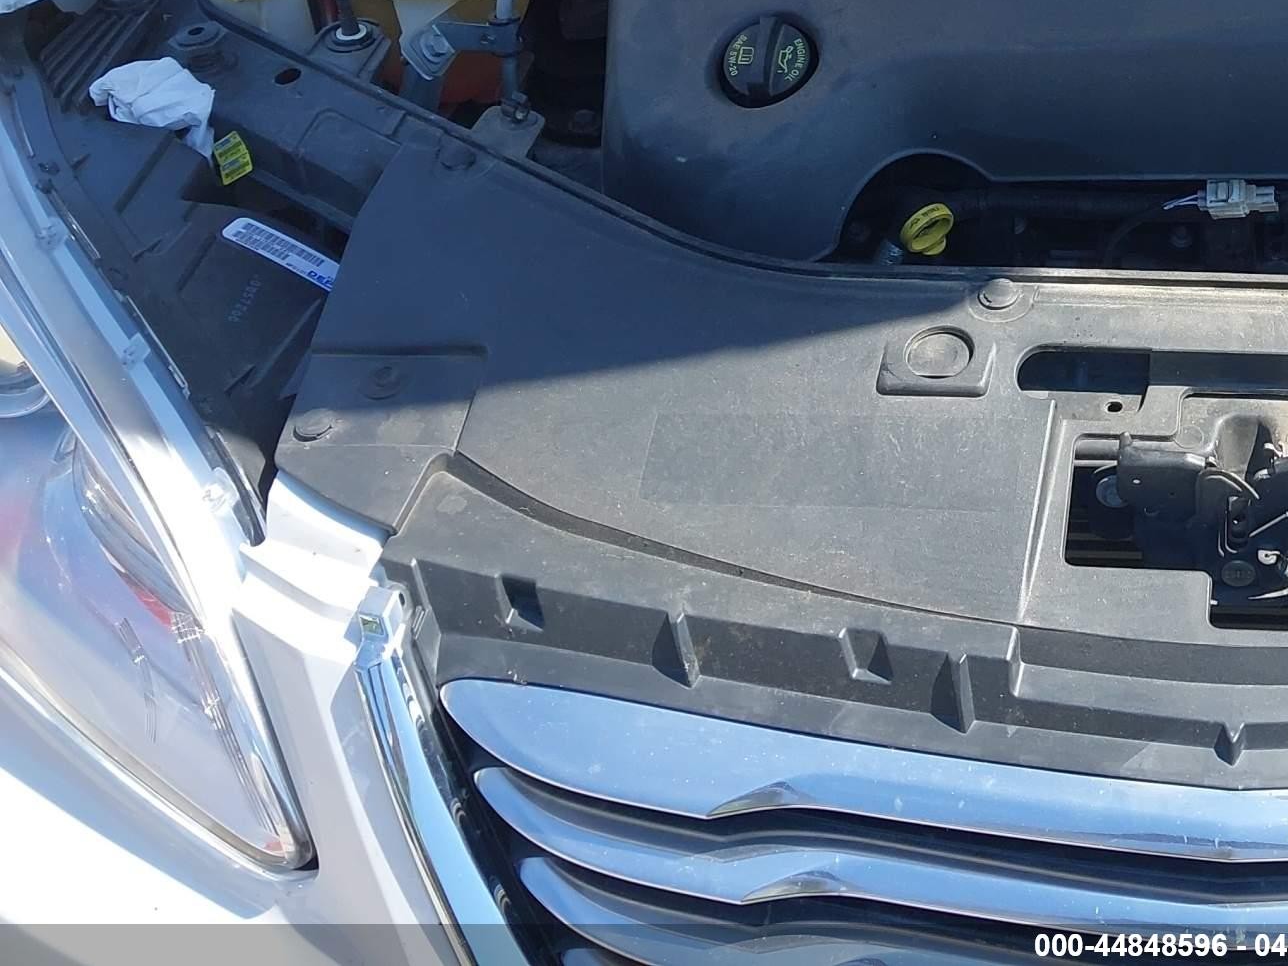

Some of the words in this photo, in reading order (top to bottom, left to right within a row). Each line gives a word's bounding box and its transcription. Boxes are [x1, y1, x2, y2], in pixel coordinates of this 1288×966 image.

[733, 34, 747, 51] SAE
[794, 38, 806, 68] ENGINE
[728, 52, 738, 76] 5W-20
[785, 70, 799, 81] OIL
